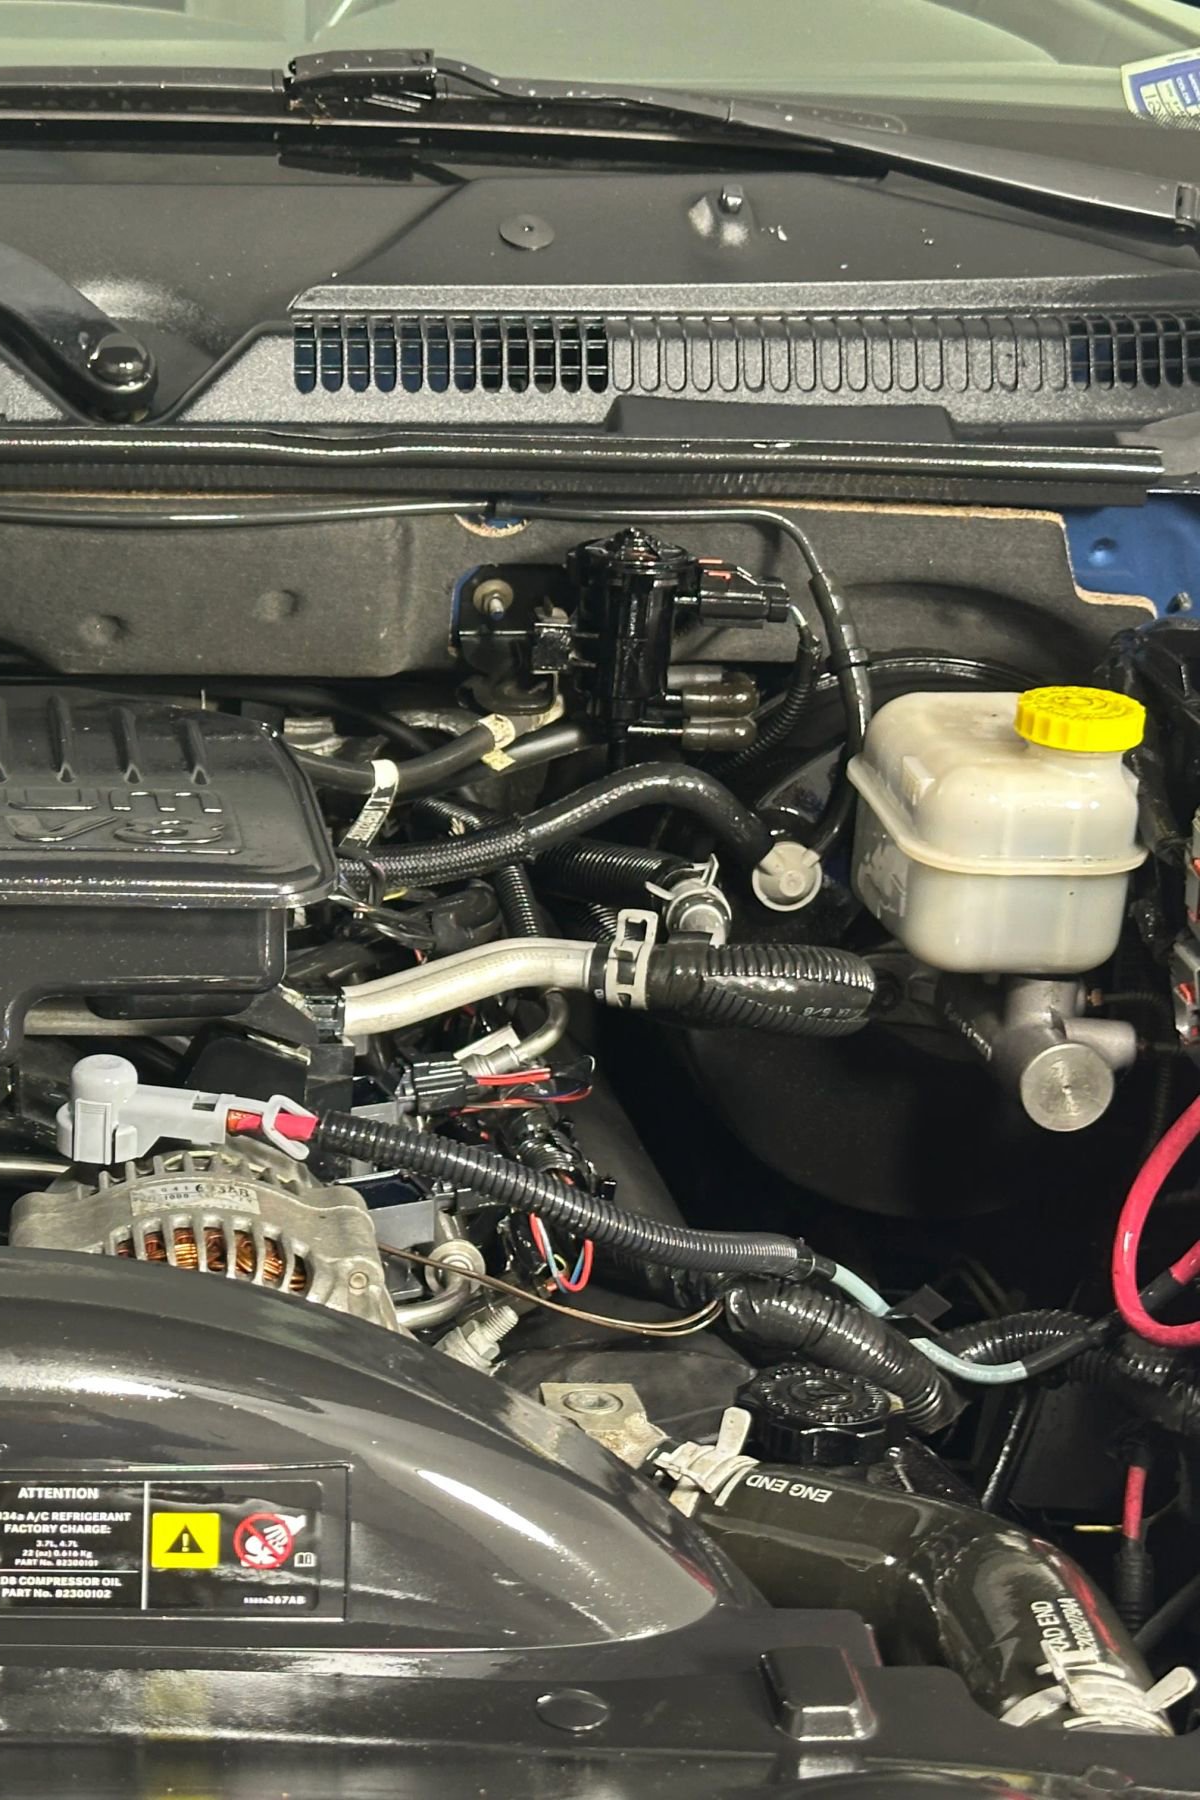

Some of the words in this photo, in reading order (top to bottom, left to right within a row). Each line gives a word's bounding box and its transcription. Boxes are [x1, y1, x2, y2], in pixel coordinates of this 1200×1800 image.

[5, 815, 224, 846] V8
[746, 1475, 790, 1493] END
[18, 1488, 98, 1498] ATTENTION
[789, 1484, 833, 1503] ENG
[26, 1511, 49, 1522] A/C
[51, 1512, 131, 1522] REFRIGERANT
[4, 1524, 57, 1534] FACTORY
[59, 1524, 111, 1534] CHARGE:
[19, 1576, 99, 1587] COMPRESSOR
[102, 1577, 122, 1587] OIL
[1, 1588, 32, 1598] PART
[33, 1588, 53, 1598] No.
[55, 1588, 112, 1599] 82300102
[1031, 1601, 1060, 1627] END
[1043, 1627, 1070, 1652] RAD
